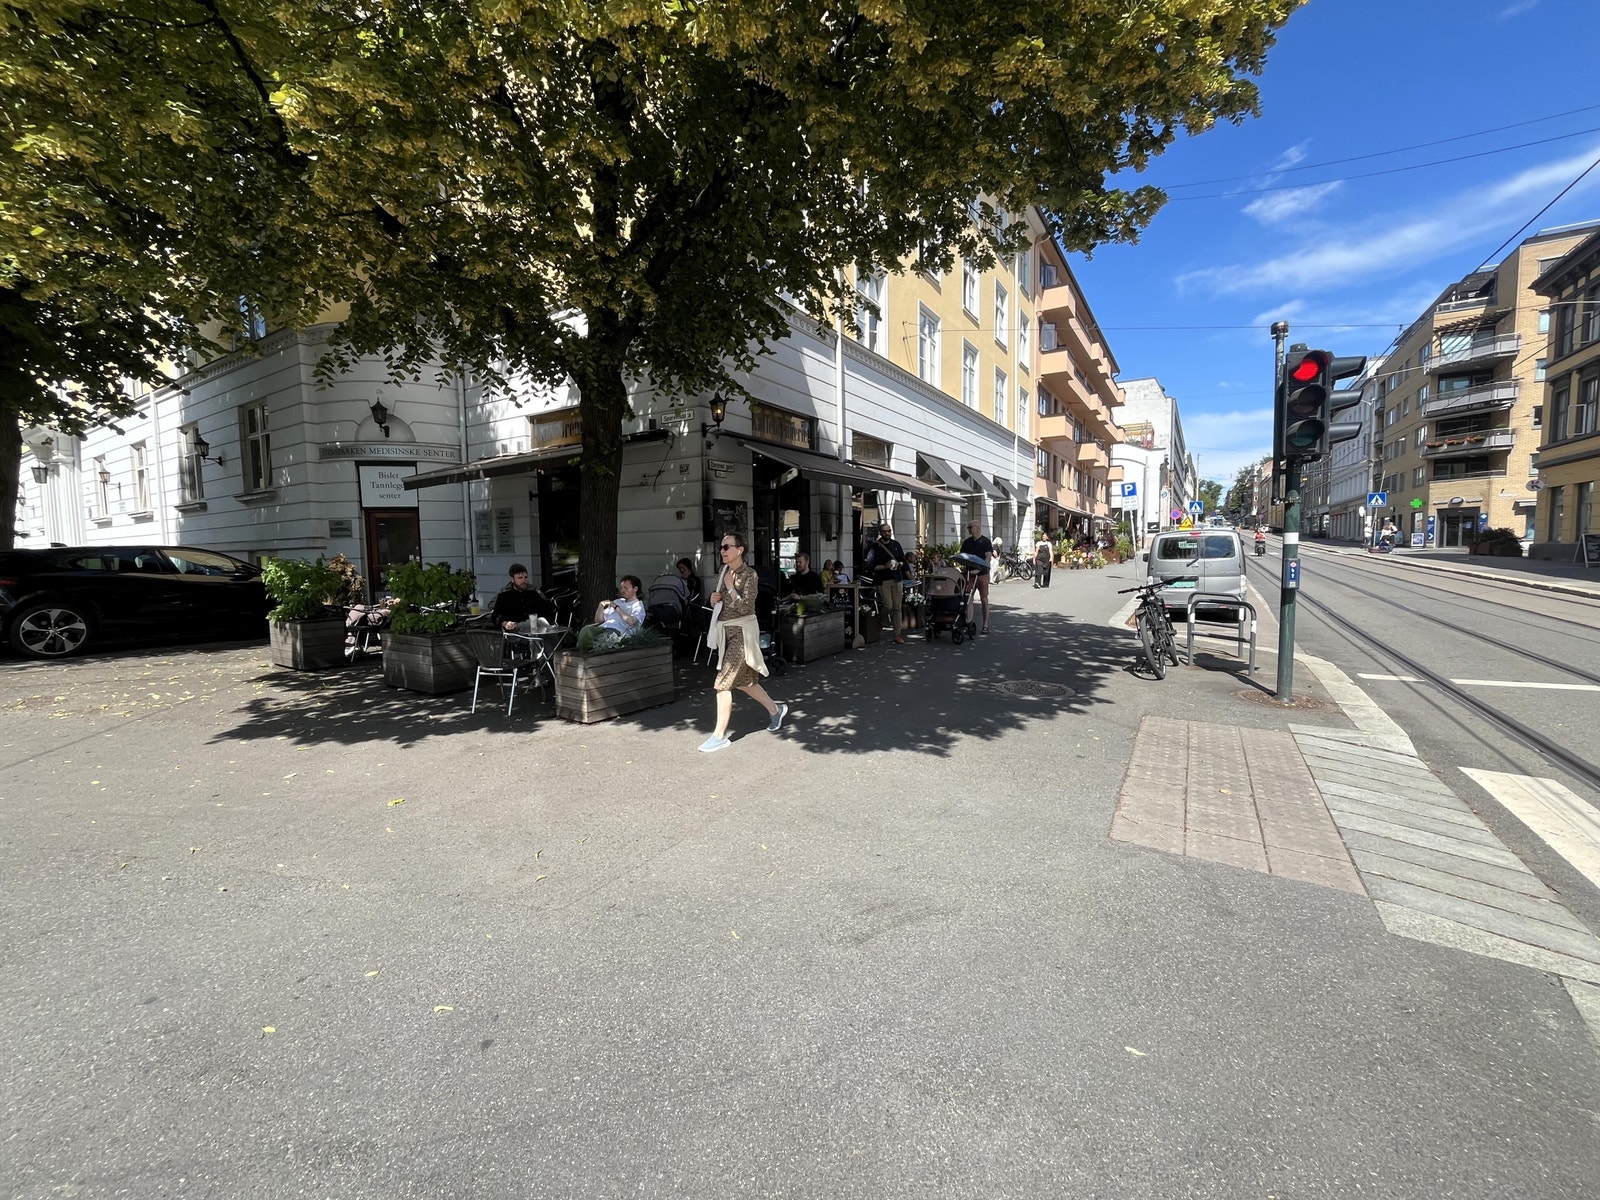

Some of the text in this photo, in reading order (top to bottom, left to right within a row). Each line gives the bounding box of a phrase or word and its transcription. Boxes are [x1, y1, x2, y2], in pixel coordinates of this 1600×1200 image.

[369, 447, 420, 456] MEDISINSKE
[423, 449, 456, 458] SENTER
[378, 471, 399, 479] Bislet
[1124, 484, 1133, 495] P
